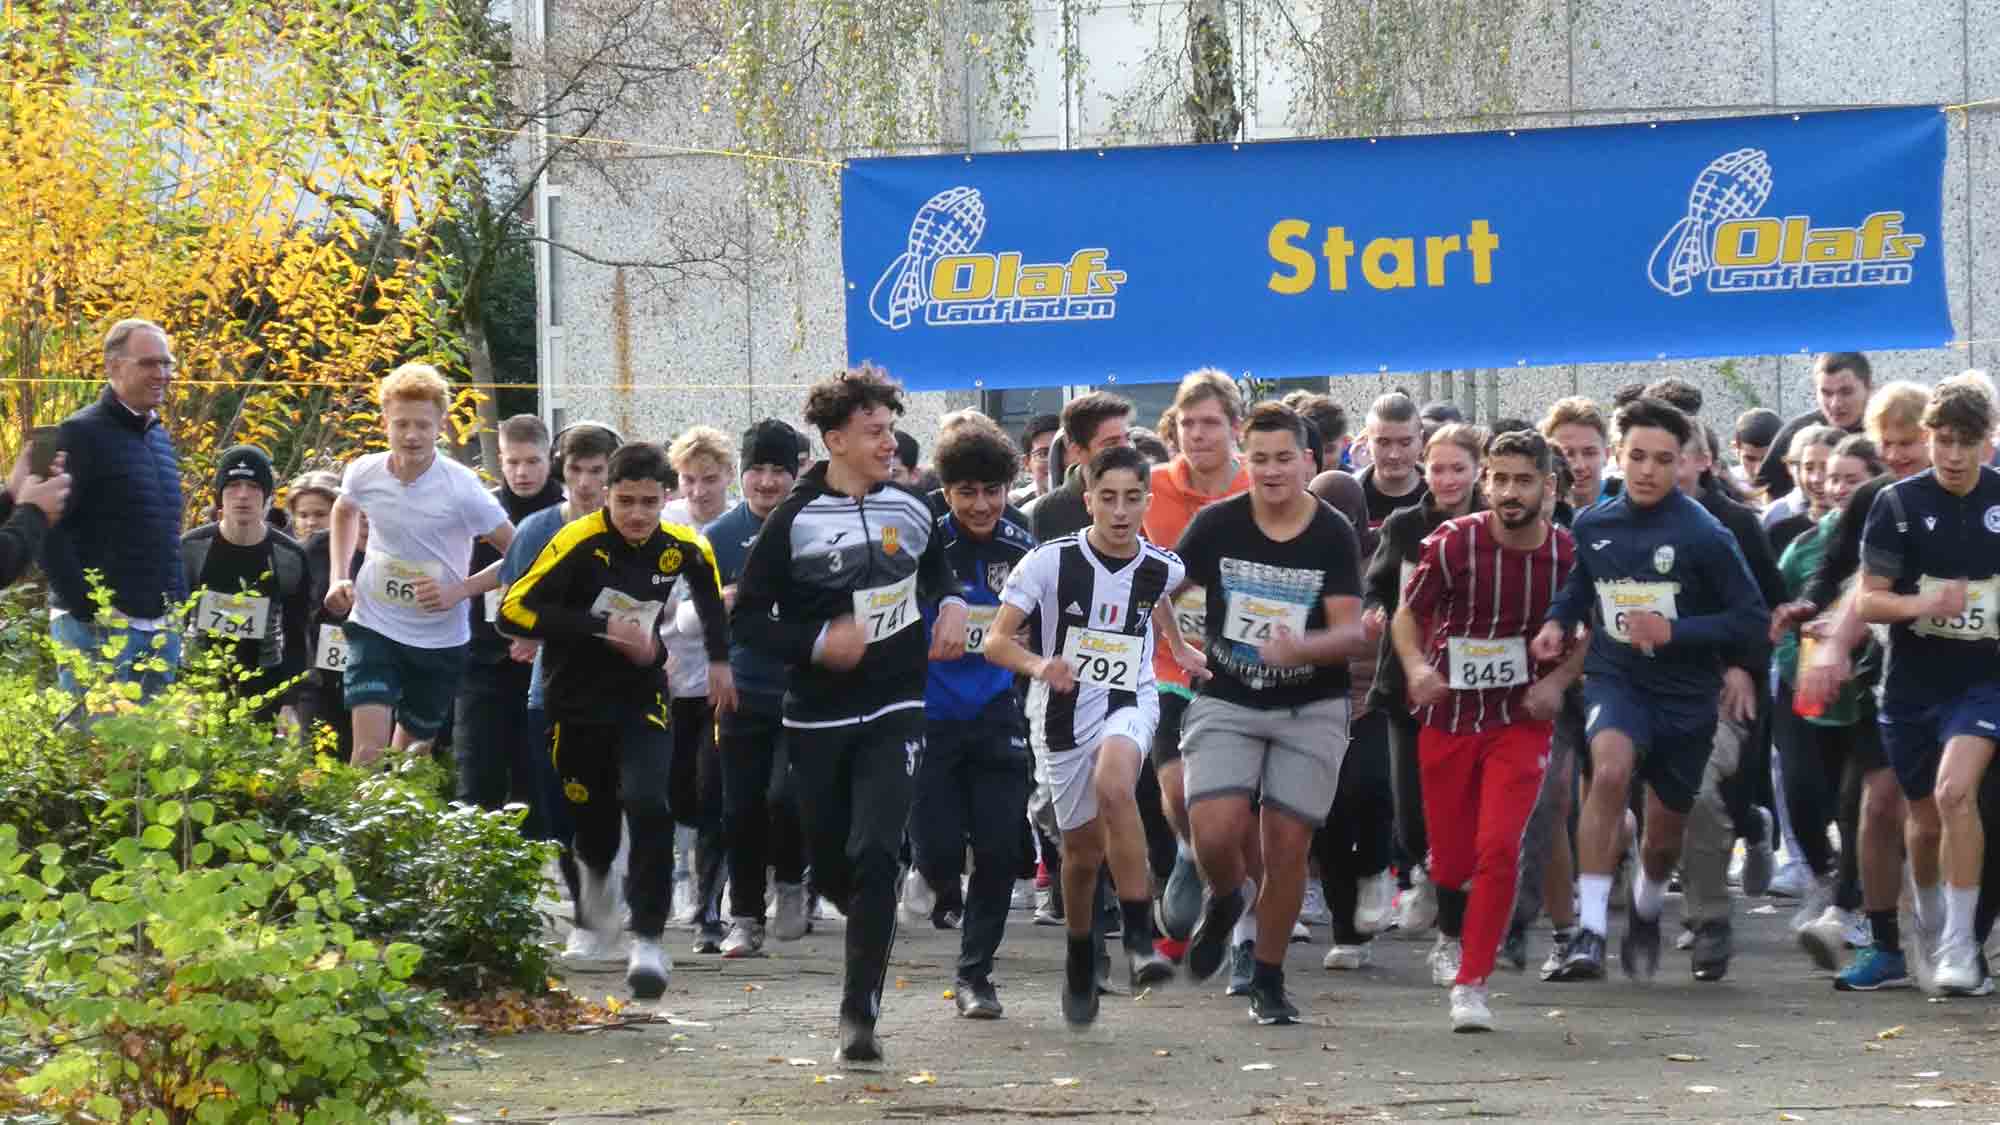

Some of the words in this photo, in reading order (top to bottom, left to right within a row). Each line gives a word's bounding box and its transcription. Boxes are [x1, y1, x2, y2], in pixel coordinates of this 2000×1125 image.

[1713, 211, 1926, 267] Olafs
[1267, 218, 1499, 294] Start
[931, 248, 1127, 302] Olafs
[1707, 264, 1912, 292] Laufladen
[925, 299, 1116, 325] Laufladen
[828, 551, 843, 573] 3
[385, 580, 415, 602] 66
[869, 599, 908, 638] 747
[1076, 653, 1128, 686] 792
[1463, 661, 1515, 686] 845
